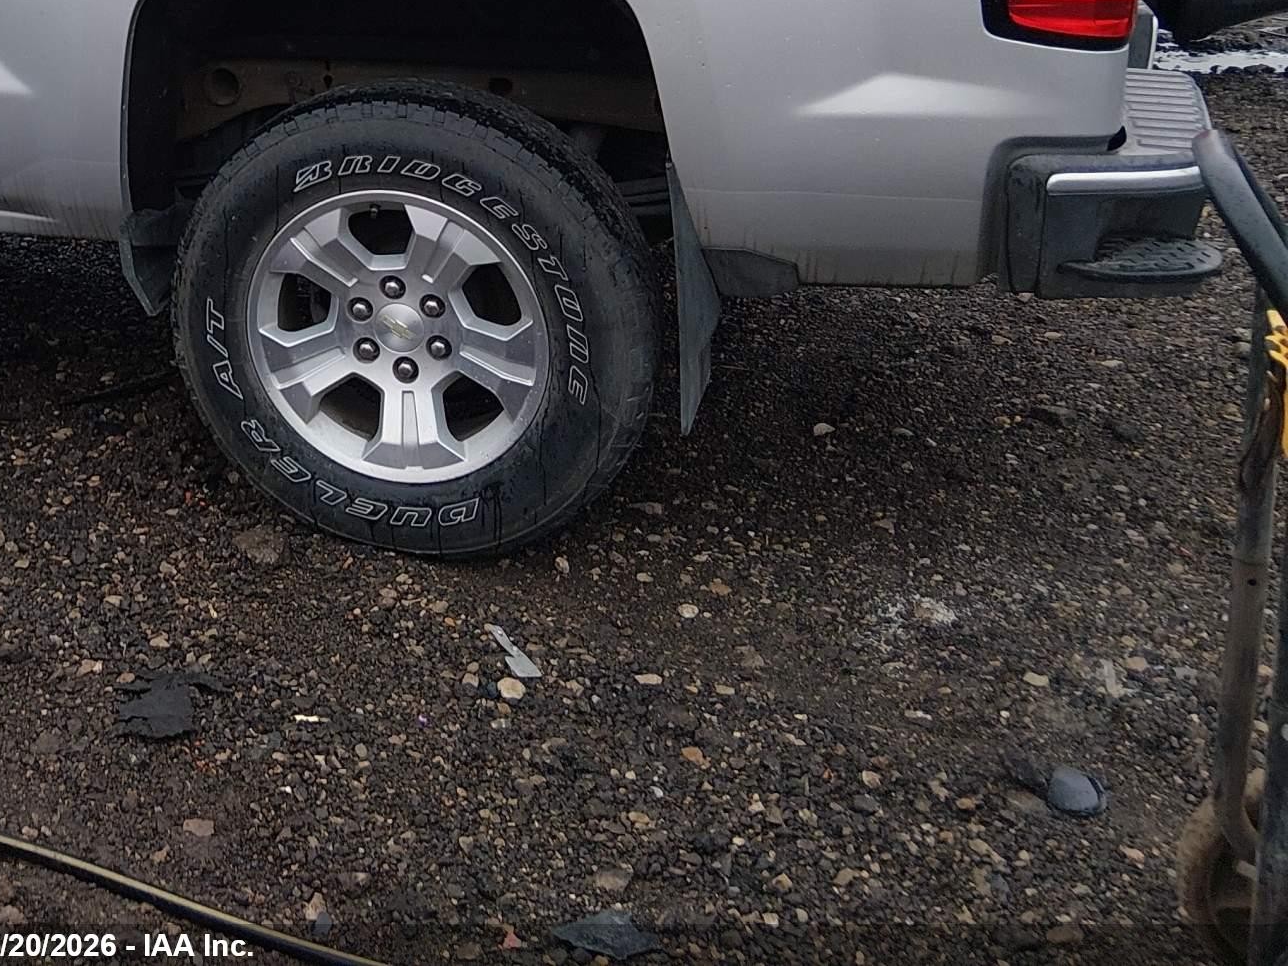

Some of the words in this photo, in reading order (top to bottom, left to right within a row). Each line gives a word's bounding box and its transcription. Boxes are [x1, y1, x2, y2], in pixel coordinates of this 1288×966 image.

[293, 155, 590, 405] BRIDGESTONE
[206, 297, 243, 400] A/T
[240, 419, 480, 527] DUELER
